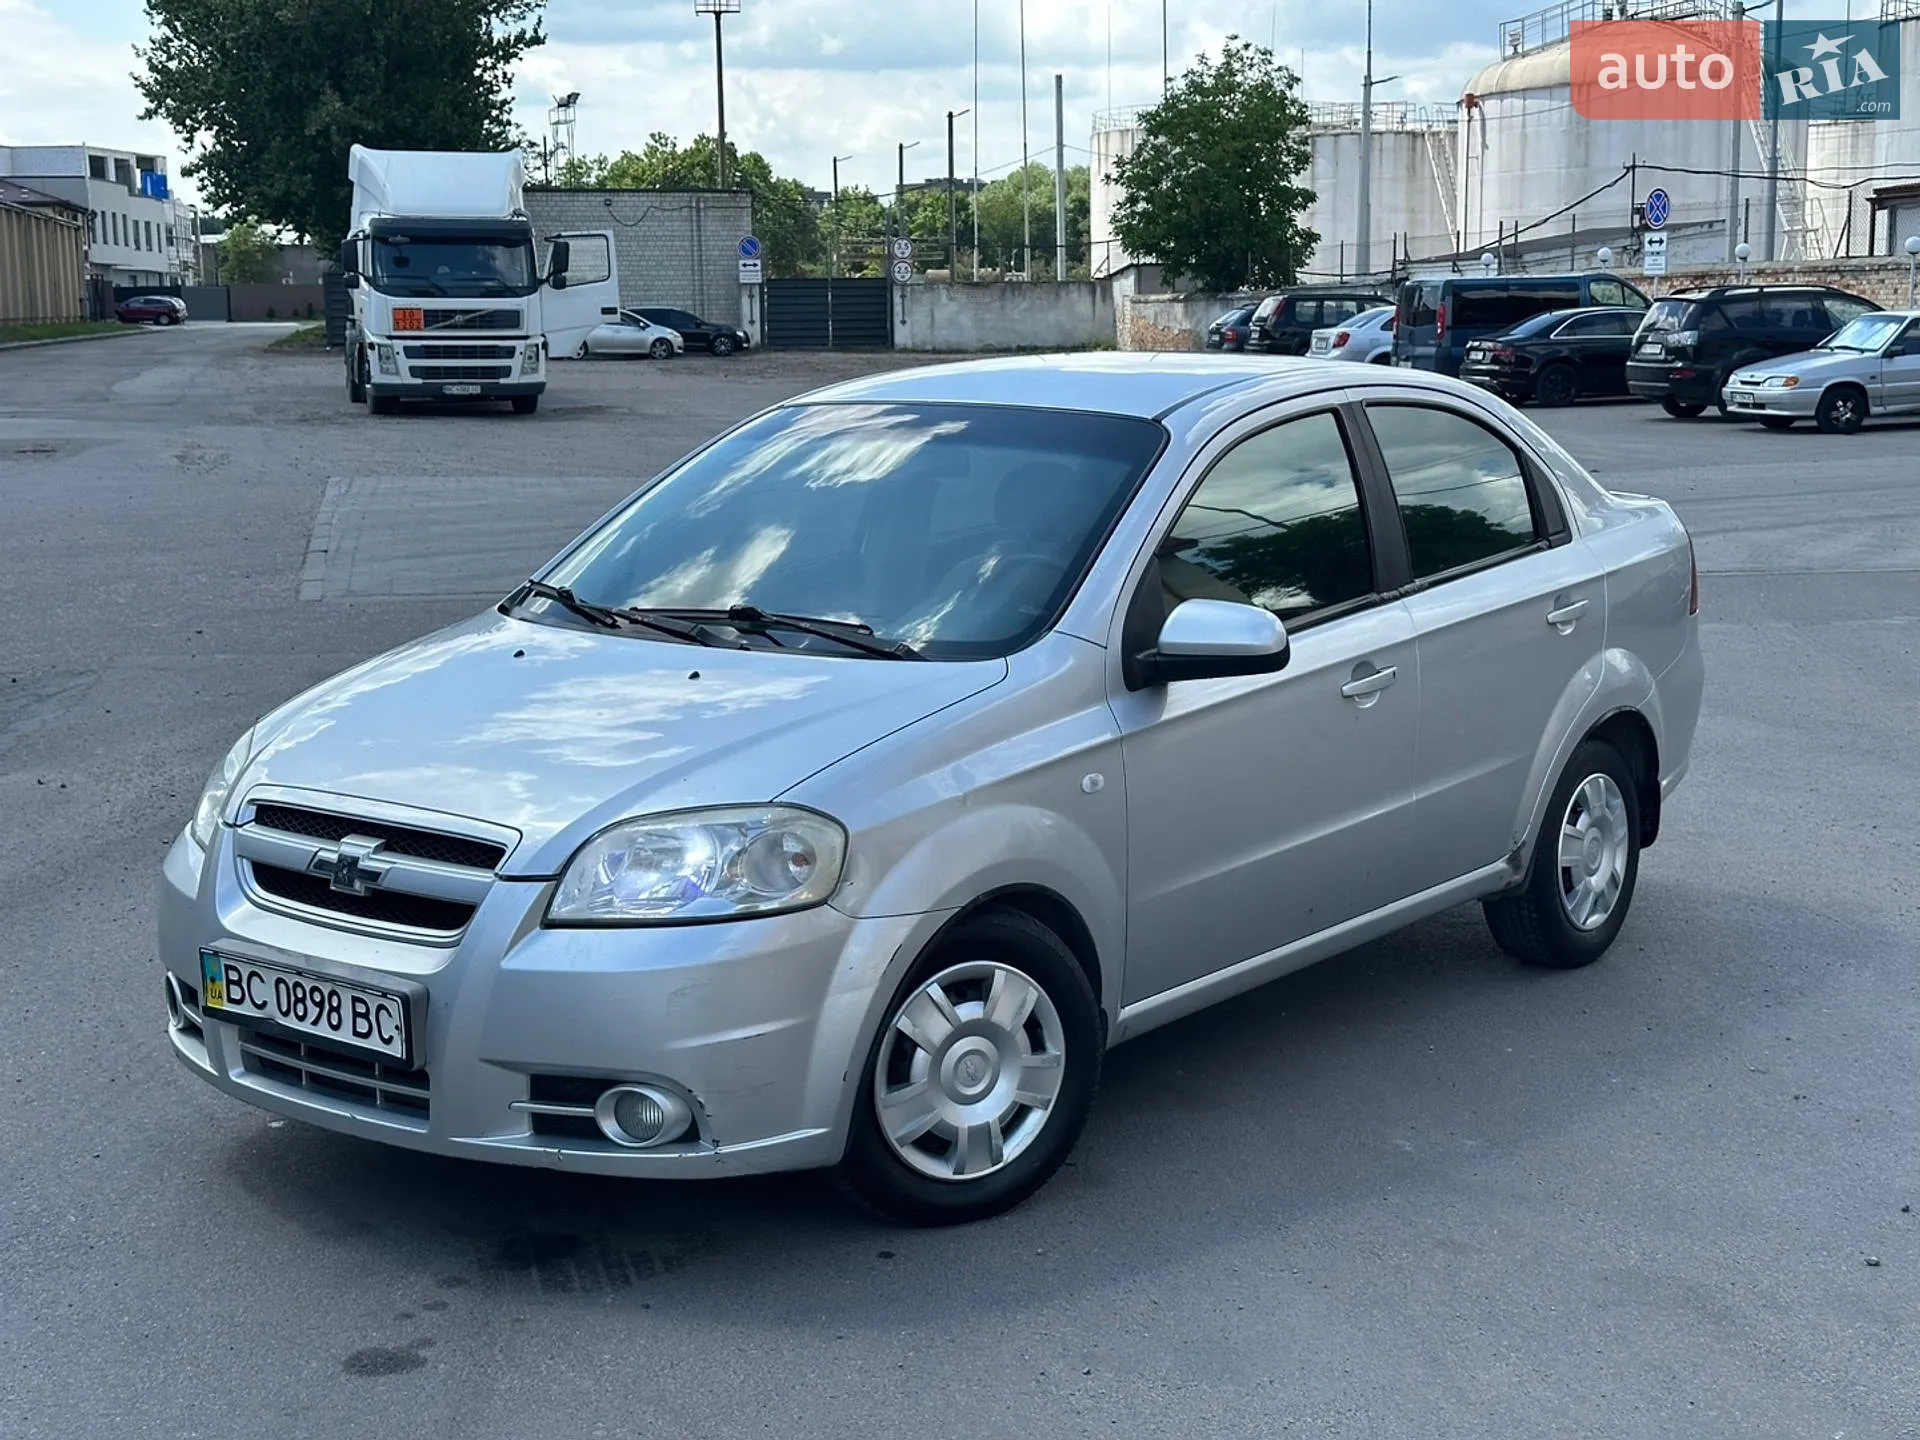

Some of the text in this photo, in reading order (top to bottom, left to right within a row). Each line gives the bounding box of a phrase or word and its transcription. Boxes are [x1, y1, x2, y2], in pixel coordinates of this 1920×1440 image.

[210, 988, 224, 1001] UA
[223, 962, 395, 1045] BC 0898 BC
